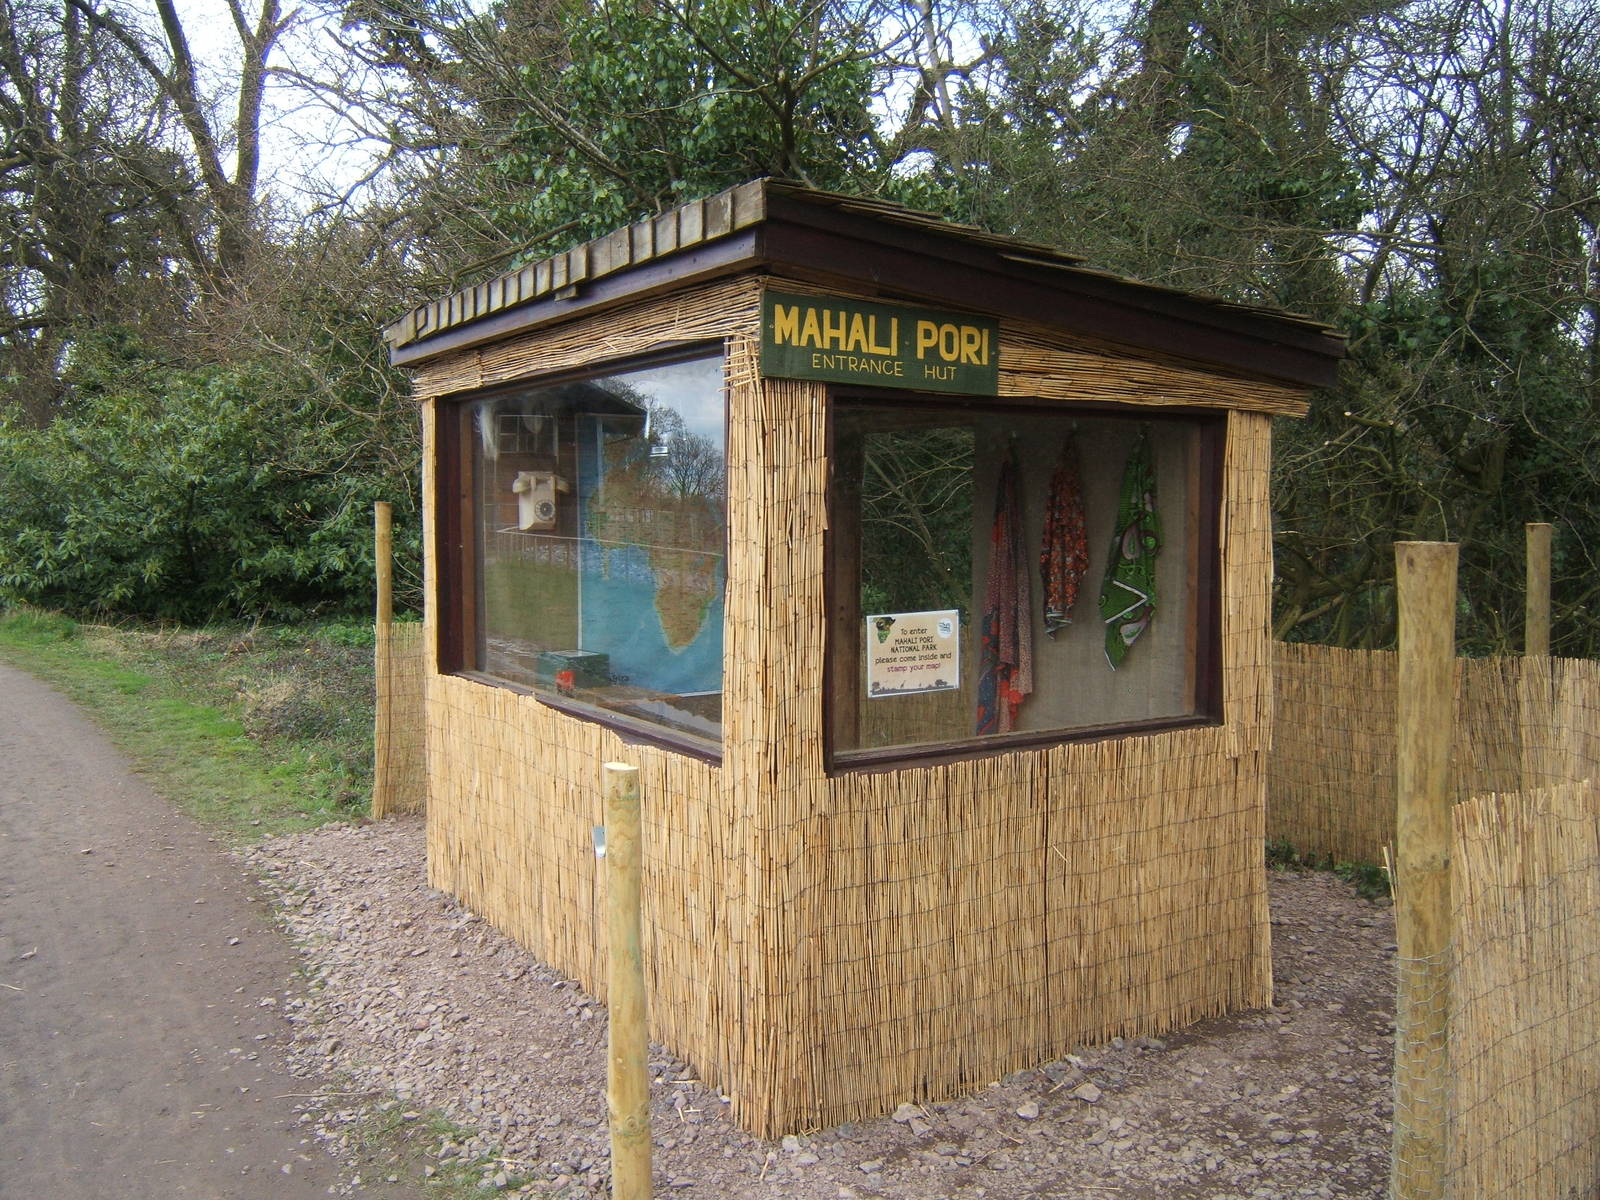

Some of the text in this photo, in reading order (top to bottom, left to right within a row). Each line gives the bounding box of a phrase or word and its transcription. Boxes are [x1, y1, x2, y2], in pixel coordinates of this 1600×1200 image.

[774, 303, 989, 366] MAHALI PORI
[812, 353, 957, 381] ENTRANCE HUT
[894, 638, 917, 646] MAHALI
[890, 646, 920, 654] NATIONAL
[875, 656, 897, 666] please
[887, 664, 908, 673] stamp
[909, 664, 924, 673] your
